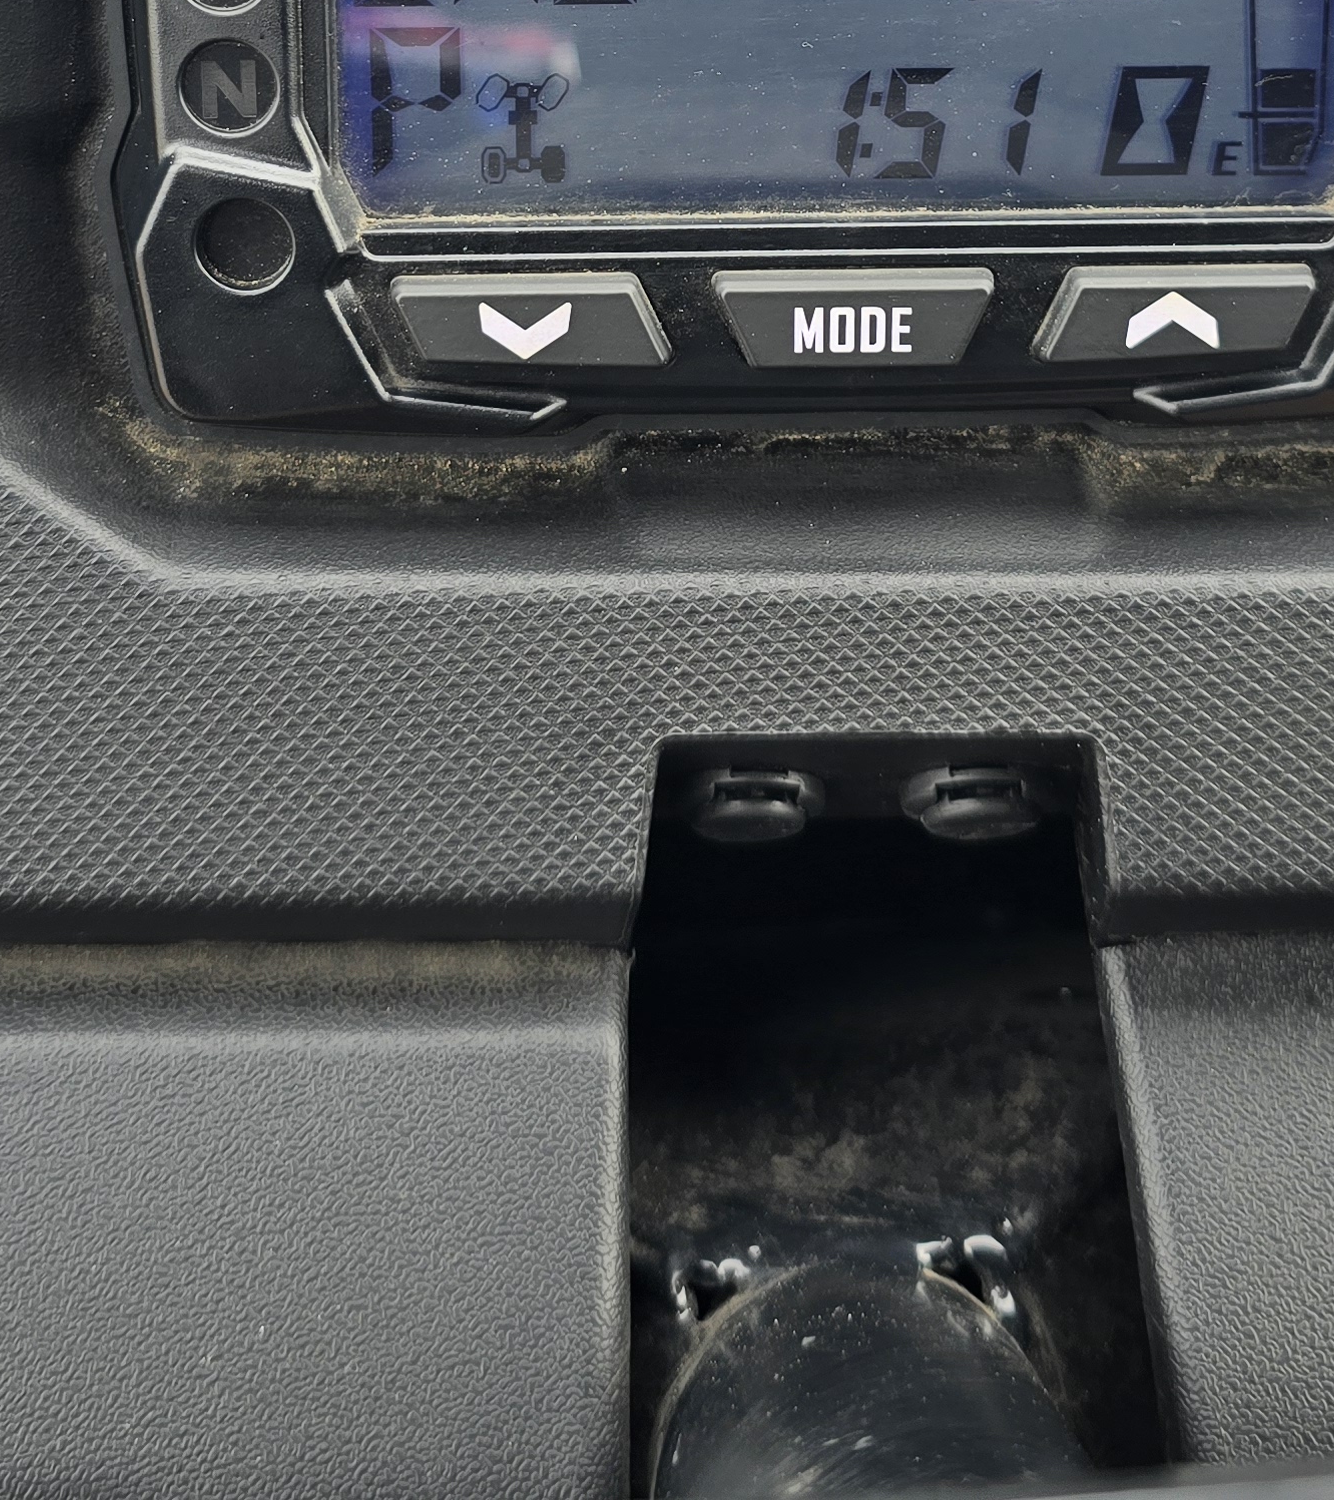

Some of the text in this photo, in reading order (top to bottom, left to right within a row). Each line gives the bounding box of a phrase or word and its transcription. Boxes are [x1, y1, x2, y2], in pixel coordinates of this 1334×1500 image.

[200, 59, 258, 119] N
[368, 26, 463, 178] P
[1211, 140, 1243, 176] E
[792, 306, 914, 354] MODE
